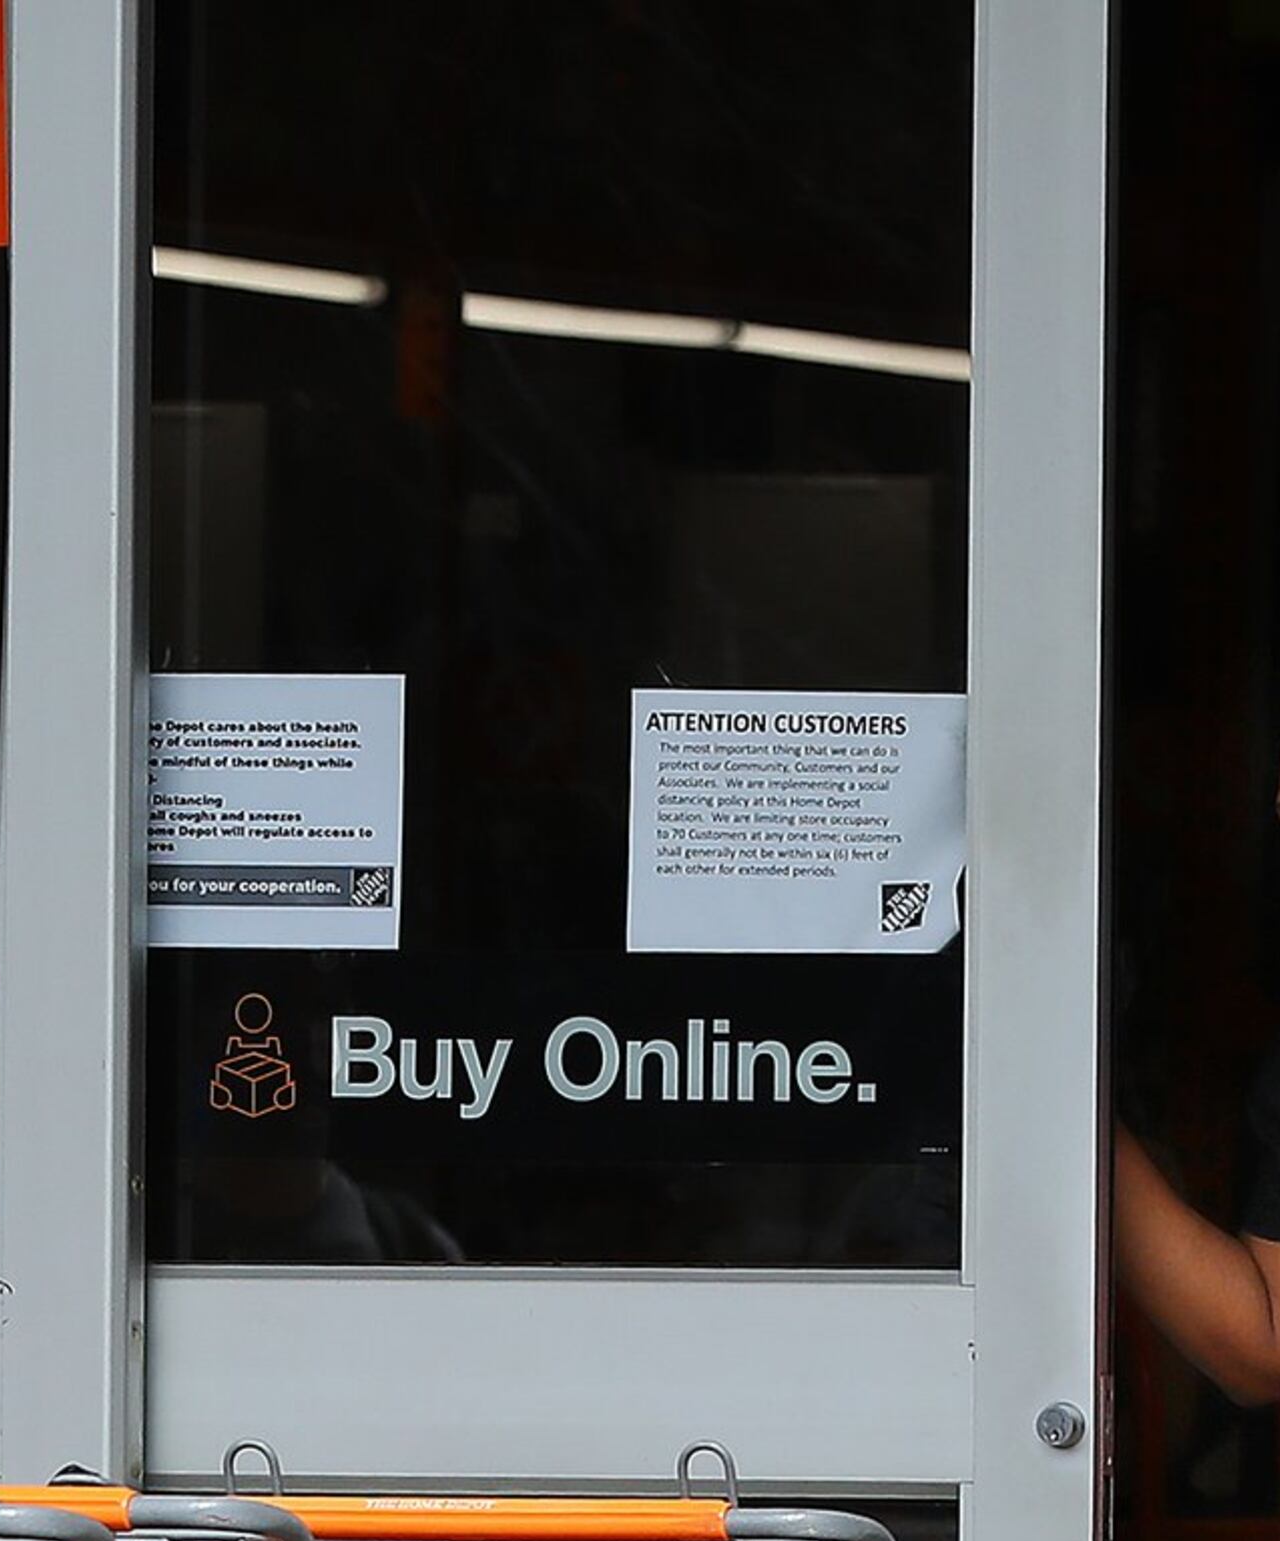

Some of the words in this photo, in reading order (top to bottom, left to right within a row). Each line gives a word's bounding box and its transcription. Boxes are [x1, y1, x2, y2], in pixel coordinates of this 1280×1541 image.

[166, 721, 204, 733] Depot
[207, 723, 245, 733] cares
[249, 722, 286, 733] about
[290, 723, 312, 733] the
[316, 722, 358, 733] health
[646, 711, 767, 733] ATTENTION
[774, 713, 908, 736] CUSTOMERS
[167, 737, 180, 747] of
[184, 738, 253, 748] customers
[257, 738, 282, 748] and
[286, 738, 361, 748] associates.
[660, 742, 680, 753] The
[683, 744, 710, 754] most
[714, 744, 768, 756] important
[773, 745, 801, 757] thing
[805, 745, 827, 756] that
[831, 748, 847, 756] we
[850, 748, 870, 756] can
[872, 746, 887, 757] do
[890, 747, 899, 757] is
[161, 757, 211, 767] mindful
[214, 757, 228, 767] of
[231, 757, 268, 767] these
[272, 758, 313, 770] things
[317, 758, 353, 768] while
[658, 760, 699, 772] protect
[702, 763, 721, 771] our
[794, 761, 853, 773] Customers
[857, 763, 878, 773] and
[881, 765, 901, 773] our
[725, 778, 743, 788] We
[747, 780, 764, 788] are
[767, 779, 846, 792] implementing
[859, 780, 890, 791] social
[152, 794, 223, 808] Distancing
[657, 794, 714, 807] distancing
[717, 795, 749, 807] policy
[753, 797, 764, 807] at
[767, 797, 787, 807] this
[790, 797, 824, 807] Home
[827, 797, 861, 809] Depot
[169, 811, 216, 823] coughs
[220, 811, 245, 820] and
[249, 812, 302, 821] sneezes
[711, 812, 730, 822] We
[733, 814, 750, 823] are
[754, 813, 795, 826] limiting
[799, 815, 827, 825] store
[830, 815, 889, 827] occupancy
[179, 826, 218, 838] Depot
[221, 826, 245, 837] will
[248, 827, 304, 839] regulate
[307, 828, 355, 838] access
[359, 827, 373, 838] to
[657, 828, 669, 839] to
[689, 829, 747, 840] Customers
[751, 831, 762, 840] at
[765, 832, 783, 843] any
[787, 833, 809, 842] one
[843, 834, 902, 843] customers
[657, 846, 681, 857] shall
[685, 847, 736, 860] generally
[740, 848, 758, 859] not
[761, 848, 775, 859] be
[778, 849, 813, 860] within
[817, 850, 831, 860] six
[852, 848, 874, 861] feet
[876, 849, 889, 861] of
[657, 863, 682, 874] each
[685, 864, 716, 875] other
[720, 864, 736, 875] for
[739, 865, 790, 876] extended
[172, 878, 195, 891] for
[199, 880, 235, 895] your
[239, 878, 341, 895] cooperation.
[330, 1016, 514, 1119] Buy
[544, 1016, 877, 1103] Online.
